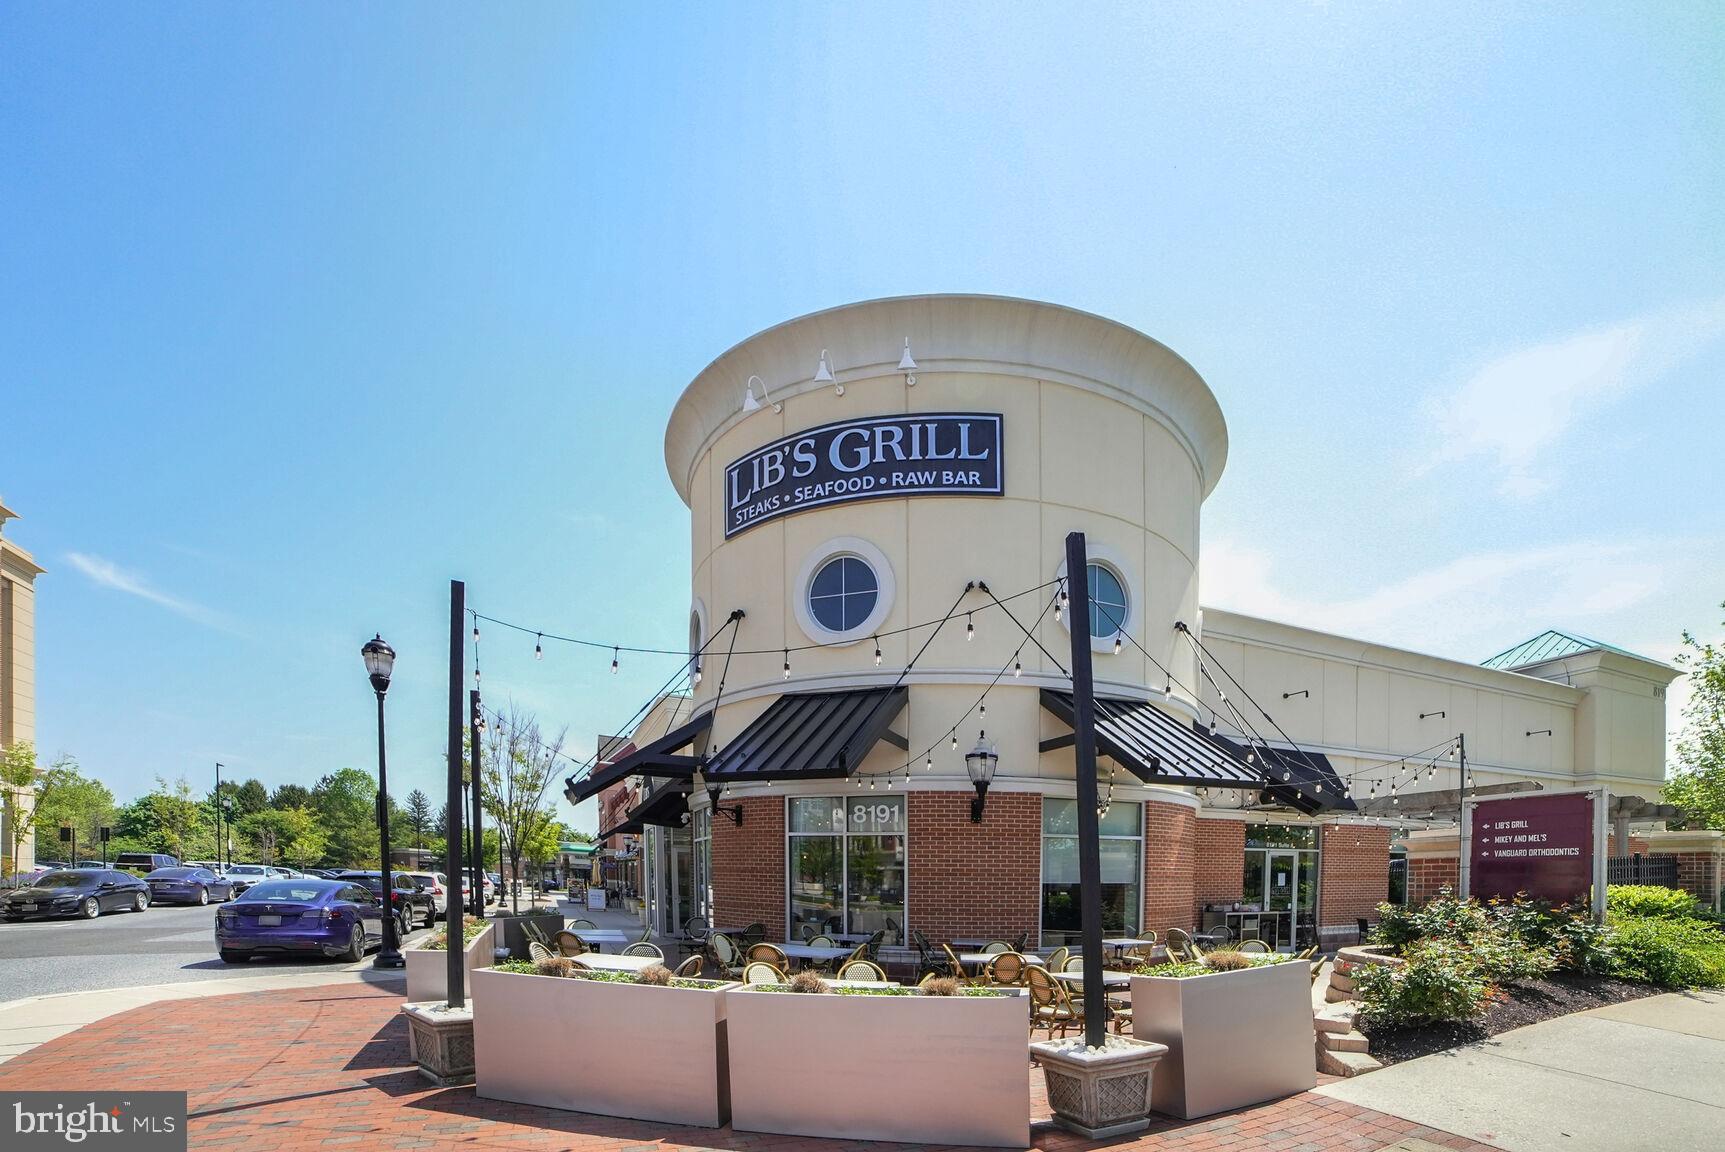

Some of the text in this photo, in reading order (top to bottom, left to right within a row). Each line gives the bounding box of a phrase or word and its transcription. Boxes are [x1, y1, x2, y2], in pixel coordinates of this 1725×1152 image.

[730, 423, 989, 510] LIB'S GRILL
[735, 471, 981, 525] STEAKS SEAFOOD RAW BAR
[853, 804, 899, 824] 8191
[1494, 820, 1528, 830] LIB'S GRILL
[1494, 834, 1547, 844] MIKEY AND MEL'S
[1494, 848, 1580, 858] VANGUARD ORTHODONTICS
